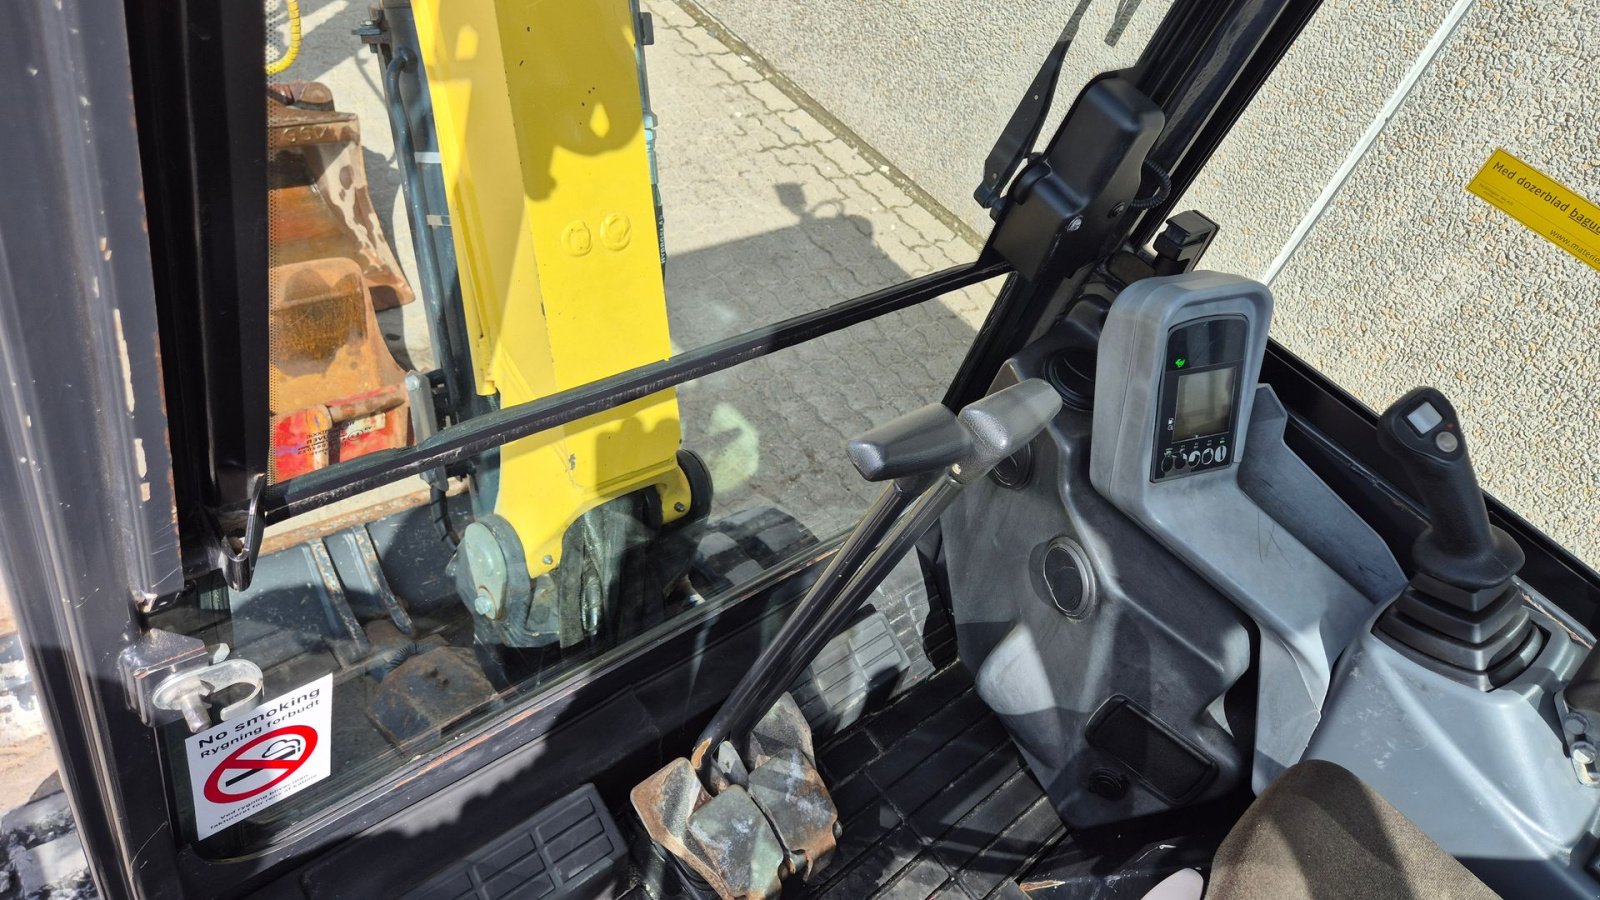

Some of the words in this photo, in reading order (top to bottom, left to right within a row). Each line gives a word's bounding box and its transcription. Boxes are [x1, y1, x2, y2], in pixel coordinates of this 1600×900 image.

[1492, 161, 1517, 180] Med
[1516, 176, 1570, 212] dozerblad
[1549, 229, 1600, 264] www.materie
[198, 731, 228, 749] No
[234, 688, 320, 732] smoking
[200, 726, 262, 759] Rygning
[266, 699, 320, 728] forbudt
